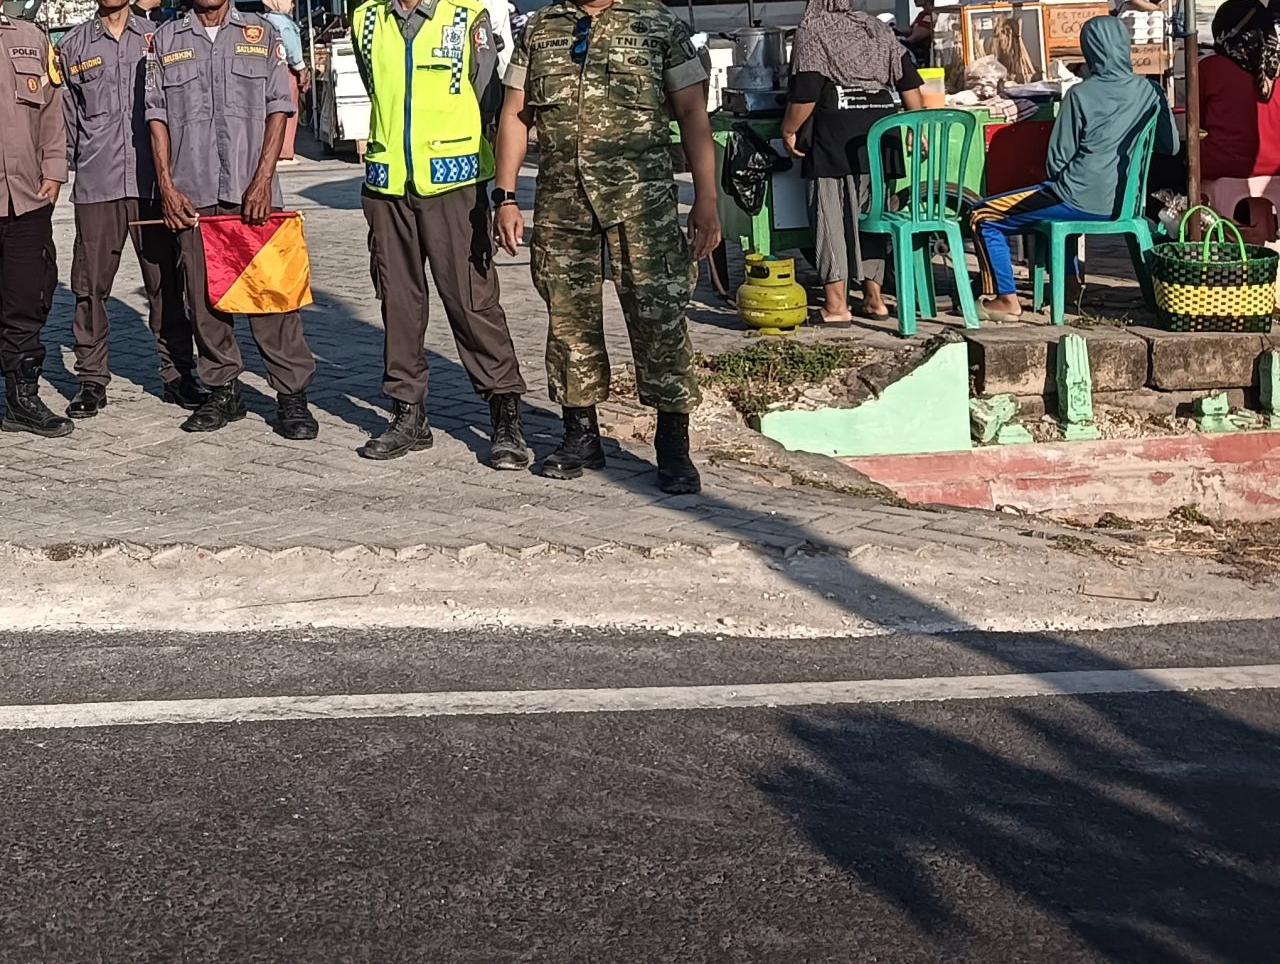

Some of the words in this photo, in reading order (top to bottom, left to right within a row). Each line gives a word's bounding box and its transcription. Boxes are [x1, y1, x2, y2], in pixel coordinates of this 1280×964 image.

[615, 36, 637, 47] TNI
[641, 38, 658, 49] AD
[12, 48, 38, 57] POLRI
